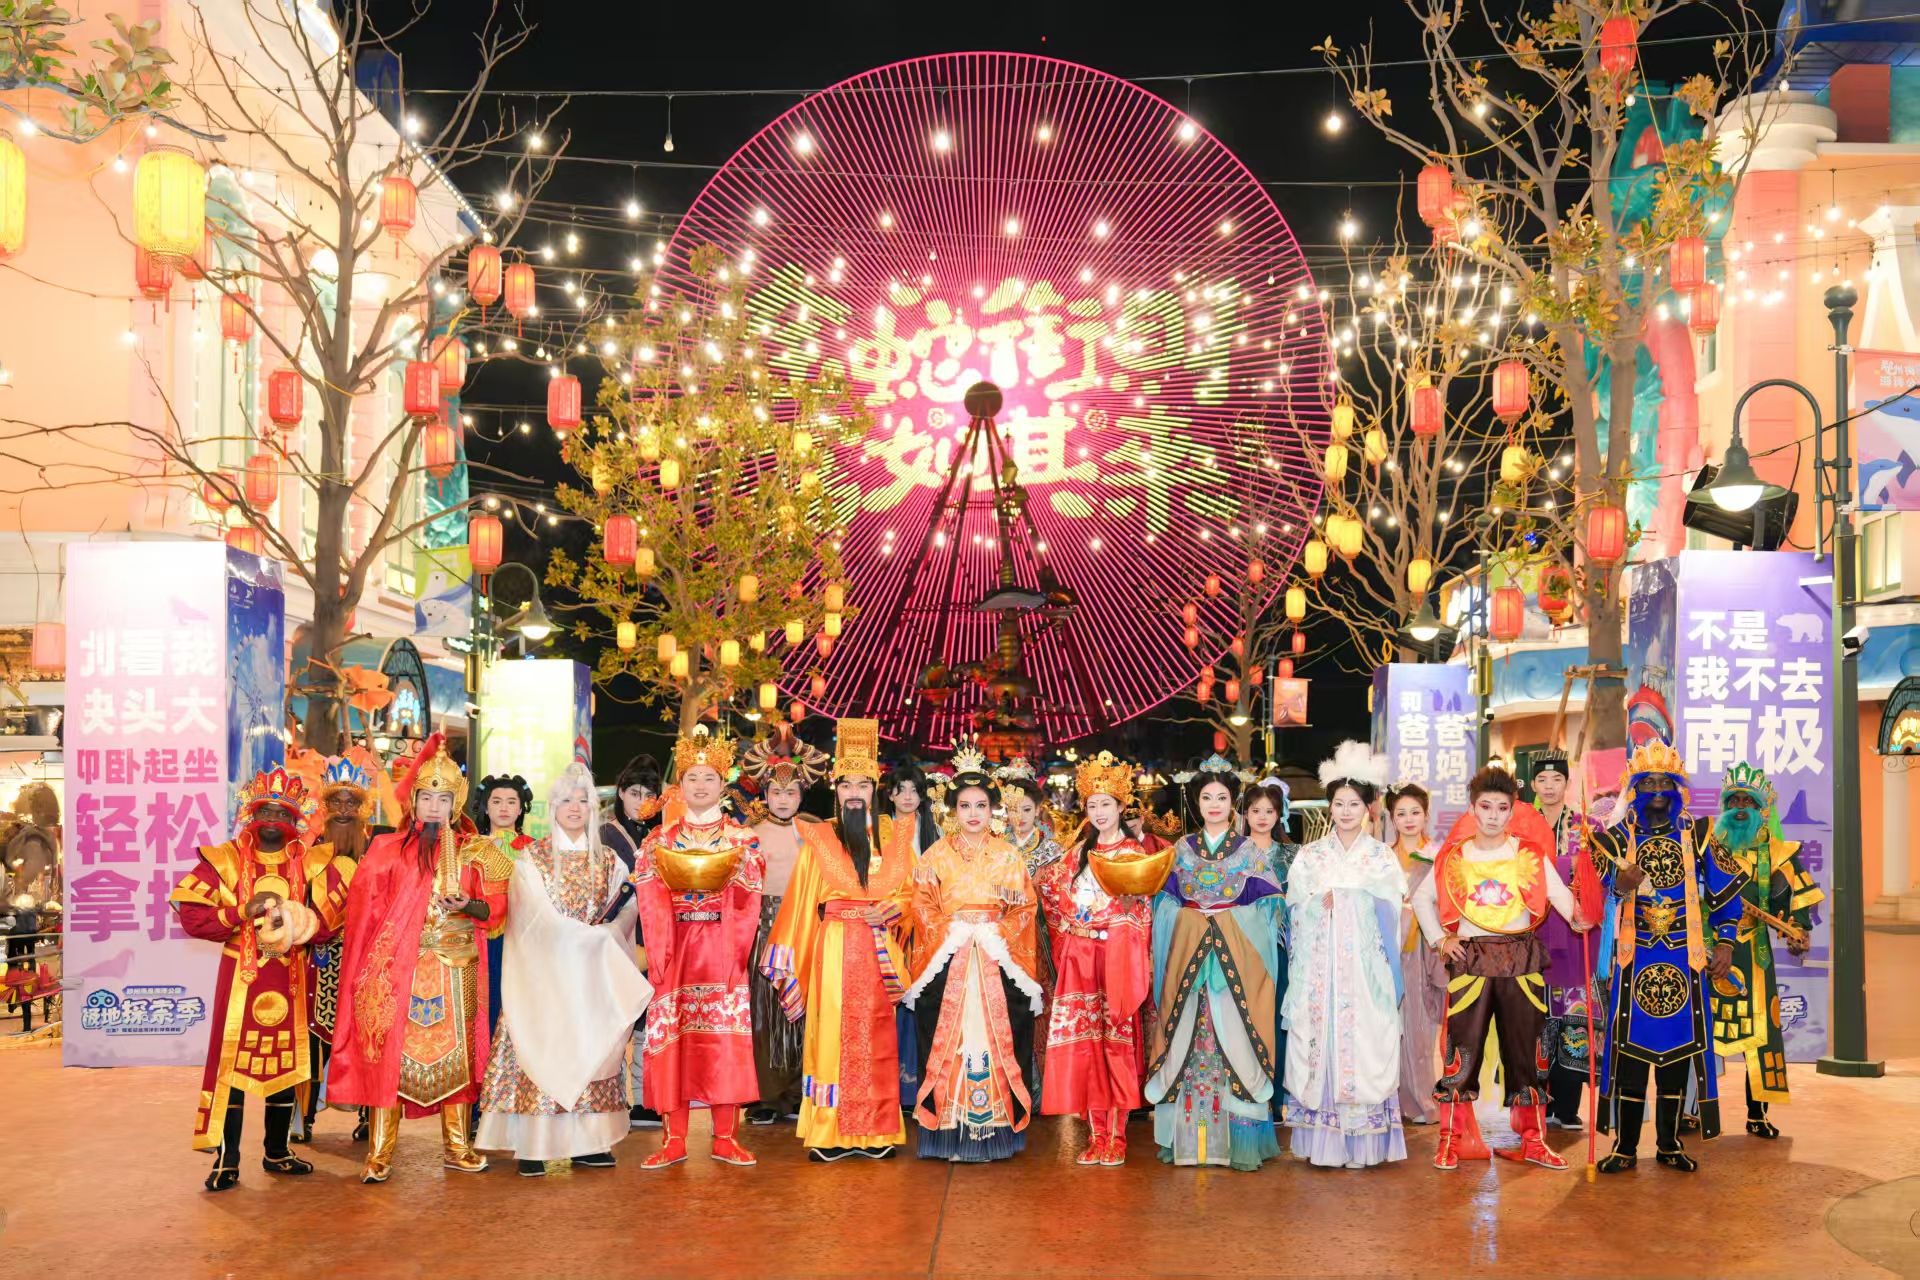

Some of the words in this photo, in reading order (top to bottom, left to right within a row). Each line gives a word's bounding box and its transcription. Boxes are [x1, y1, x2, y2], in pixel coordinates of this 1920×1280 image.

[1688, 610, 1769, 651] 不是
[1686, 655, 1824, 703] 我不去
[1397, 713, 1467, 747] 爸爸
[1684, 704, 1825, 776] 南极
[1398, 748, 1468, 783] 妈妈
[76, 791, 220, 865] 轻松
[82, 998, 202, 1027] 极地探索季
